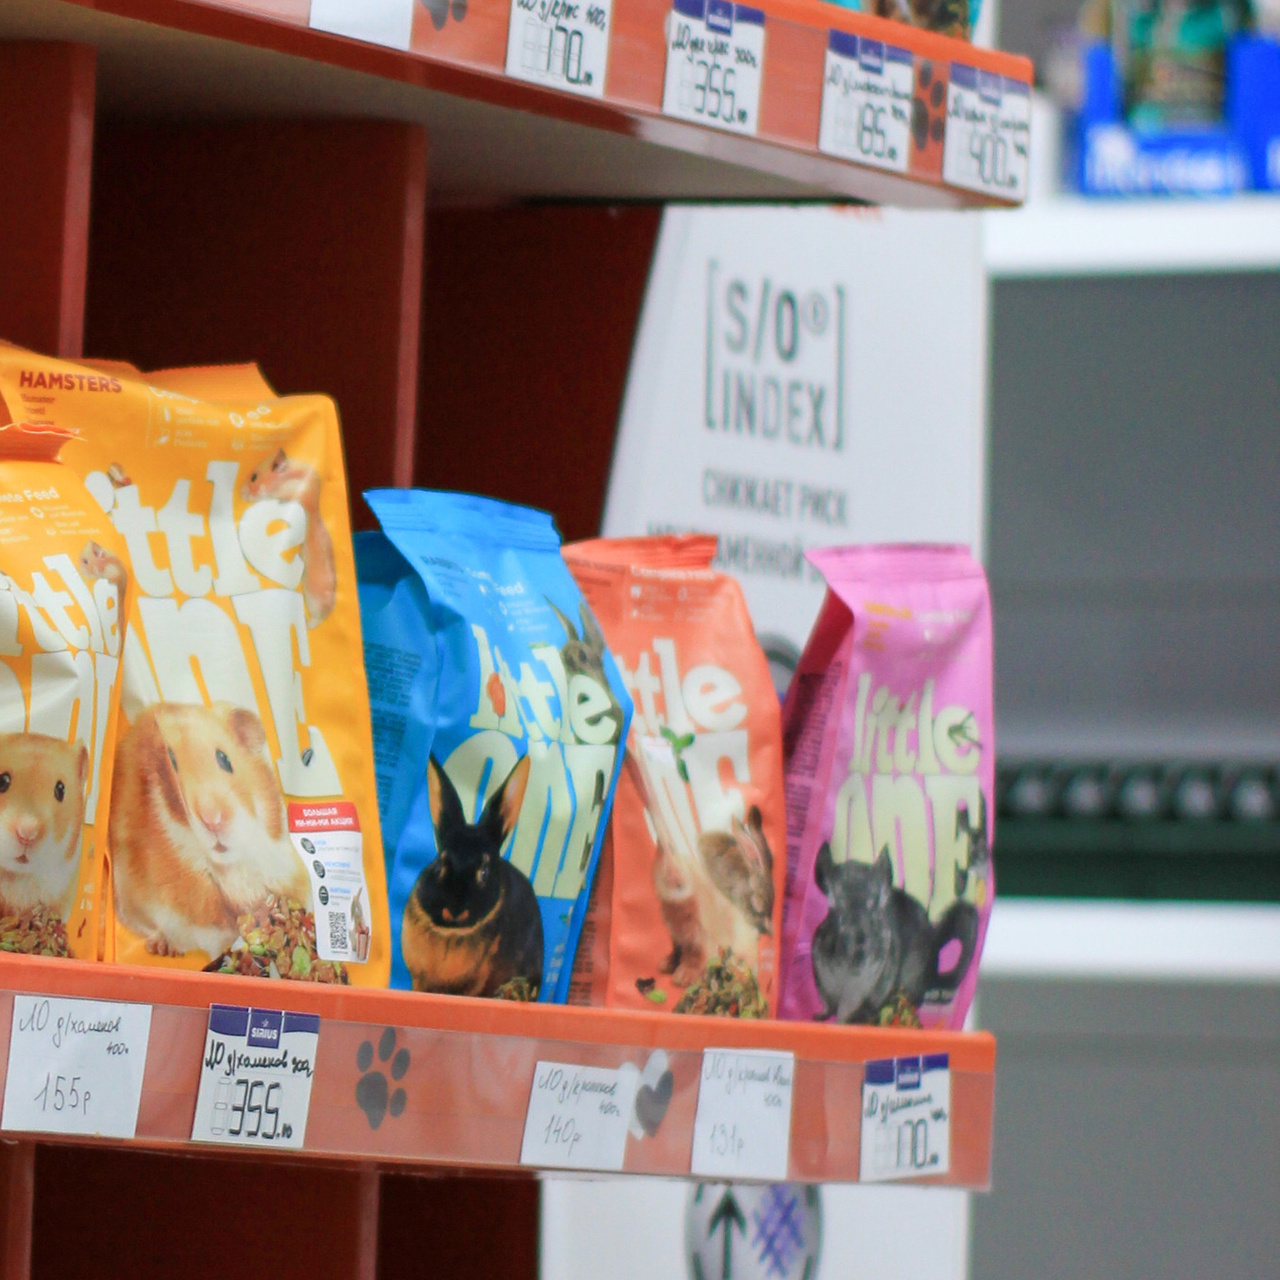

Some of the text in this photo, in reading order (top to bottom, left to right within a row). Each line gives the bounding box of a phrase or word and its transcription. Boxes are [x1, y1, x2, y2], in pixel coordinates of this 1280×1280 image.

[19, 370, 123, 394] HAMSTERS
[721, 357, 828, 450] INDEX
[23, 486, 60, 502] Feed
[702, 468, 848, 526] СНИЖАЕТ РИСК
[250, 1026, 279, 1042] SIRIUS
[33, 1071, 92, 1115] 155р
